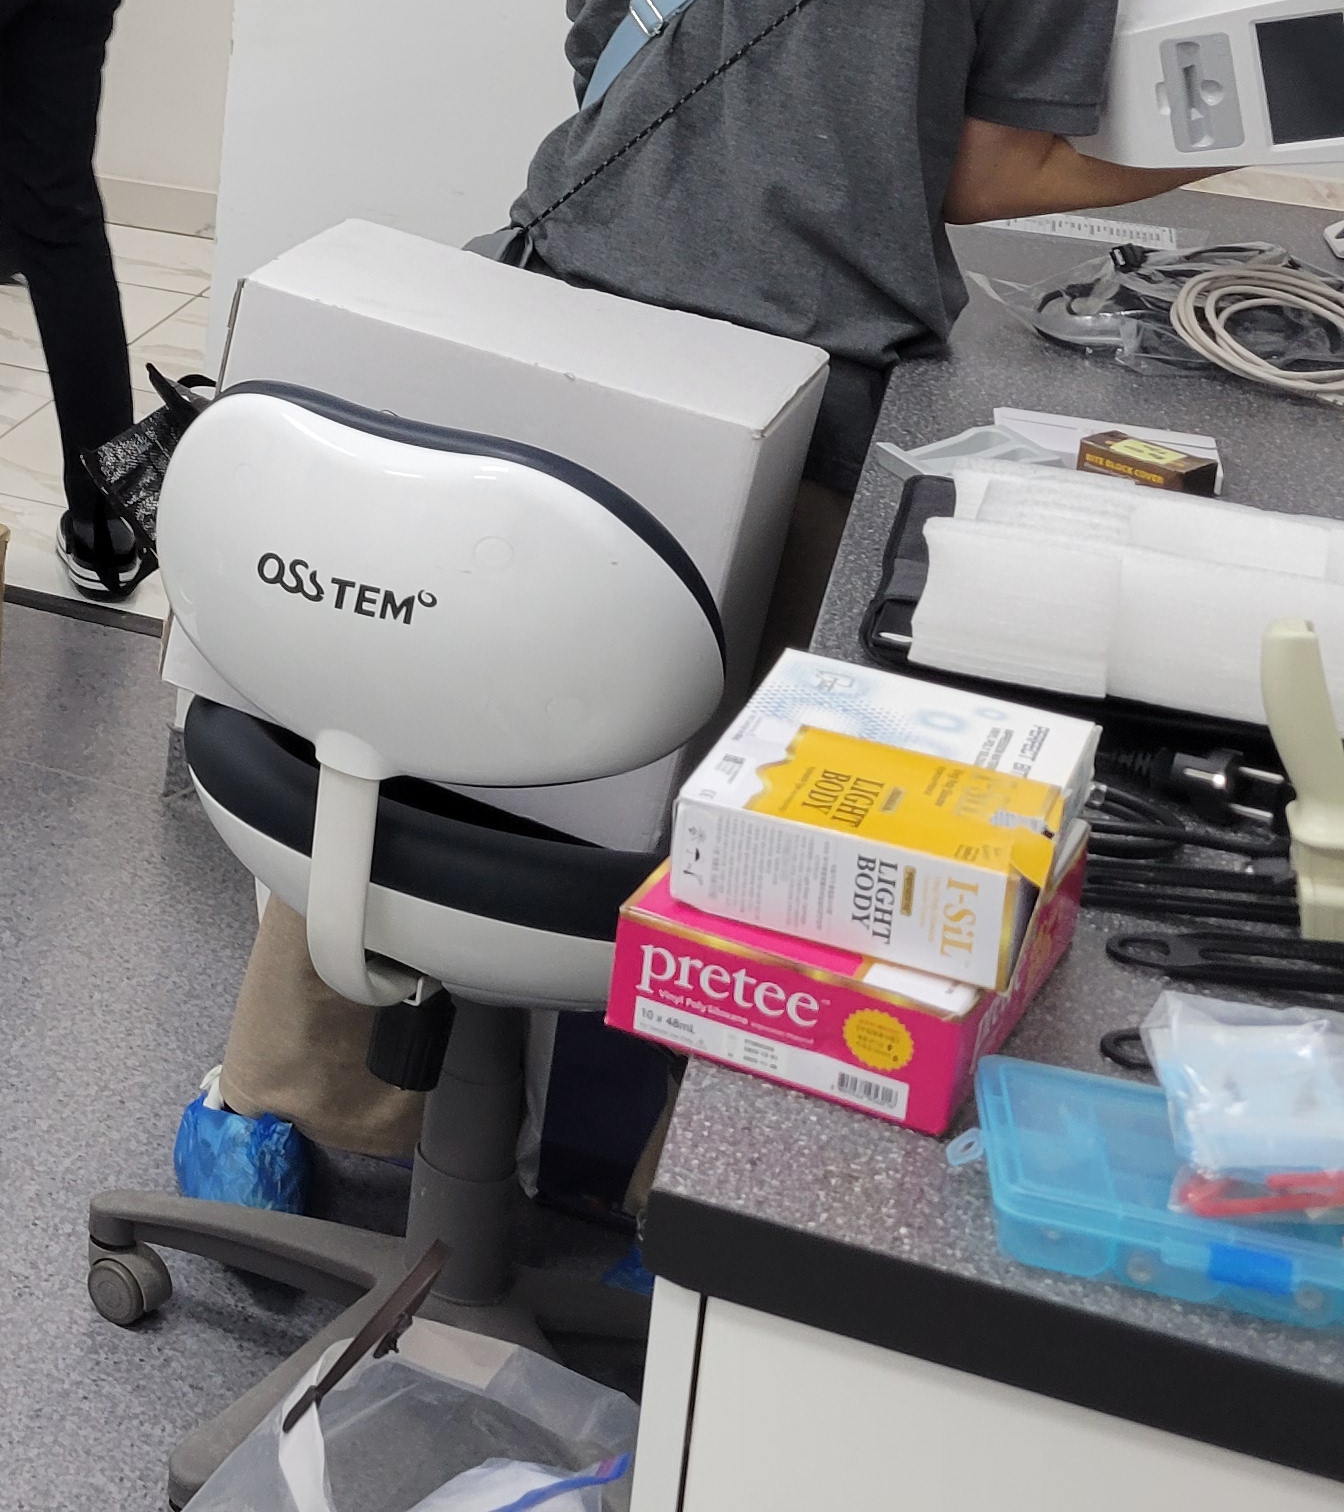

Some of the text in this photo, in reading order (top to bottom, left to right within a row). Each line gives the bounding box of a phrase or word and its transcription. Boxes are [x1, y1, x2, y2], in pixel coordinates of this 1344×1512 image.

[257, 552, 421, 625] OSSTEM
[802, 769, 852, 816] BODY
[831, 777, 885, 828] LIGHT
[851, 854, 877, 931] BODY
[872, 860, 899, 944] LIGHT
[635, 944, 820, 1026] pretee
[641, 1006, 654, 1021] 10
